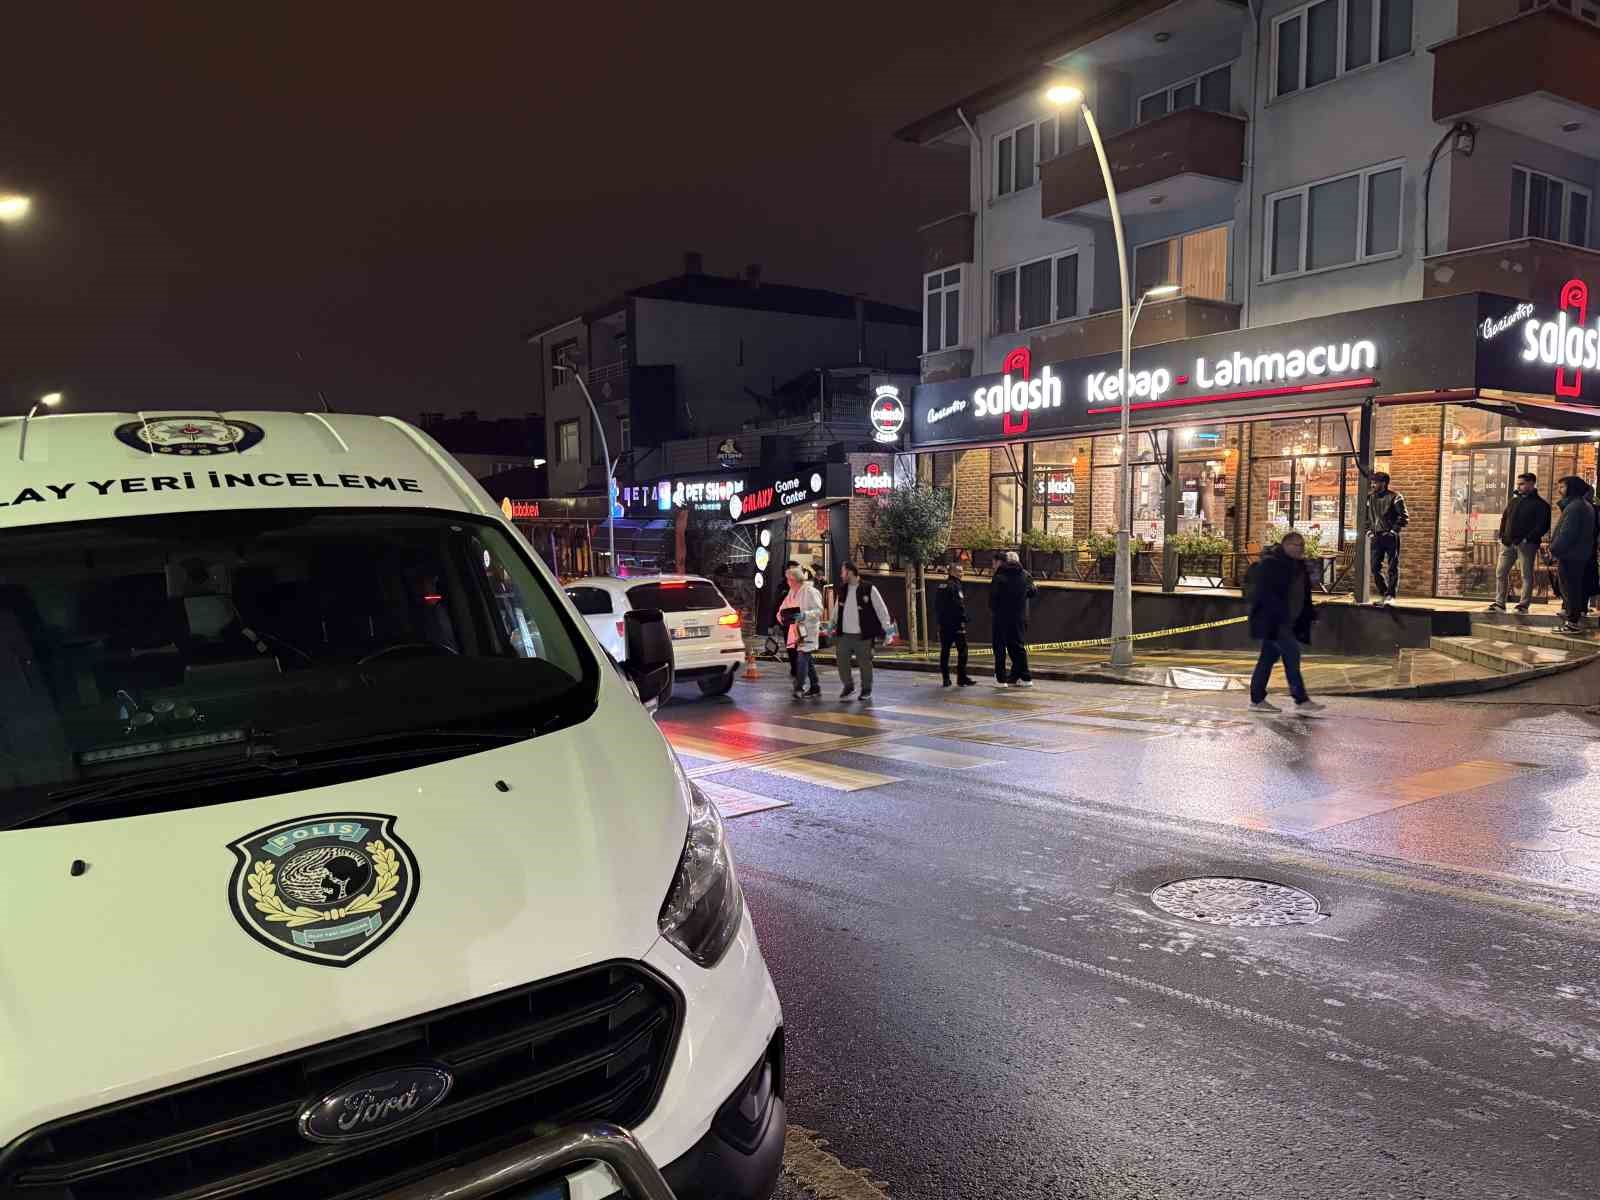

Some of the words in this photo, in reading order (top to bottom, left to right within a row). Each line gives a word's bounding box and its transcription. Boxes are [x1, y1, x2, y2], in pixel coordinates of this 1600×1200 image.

[1087, 366, 1170, 402] Kebap
[1196, 340, 1377, 389] Lahmacun
[974, 365, 1062, 417] salash
[88, 471, 194, 494] YERİ
[208, 471, 423, 493] İNCELEME
[686, 483, 705, 502] PET
[743, 487, 774, 514] GALAXY
[338, 1079, 419, 1130] Ford
